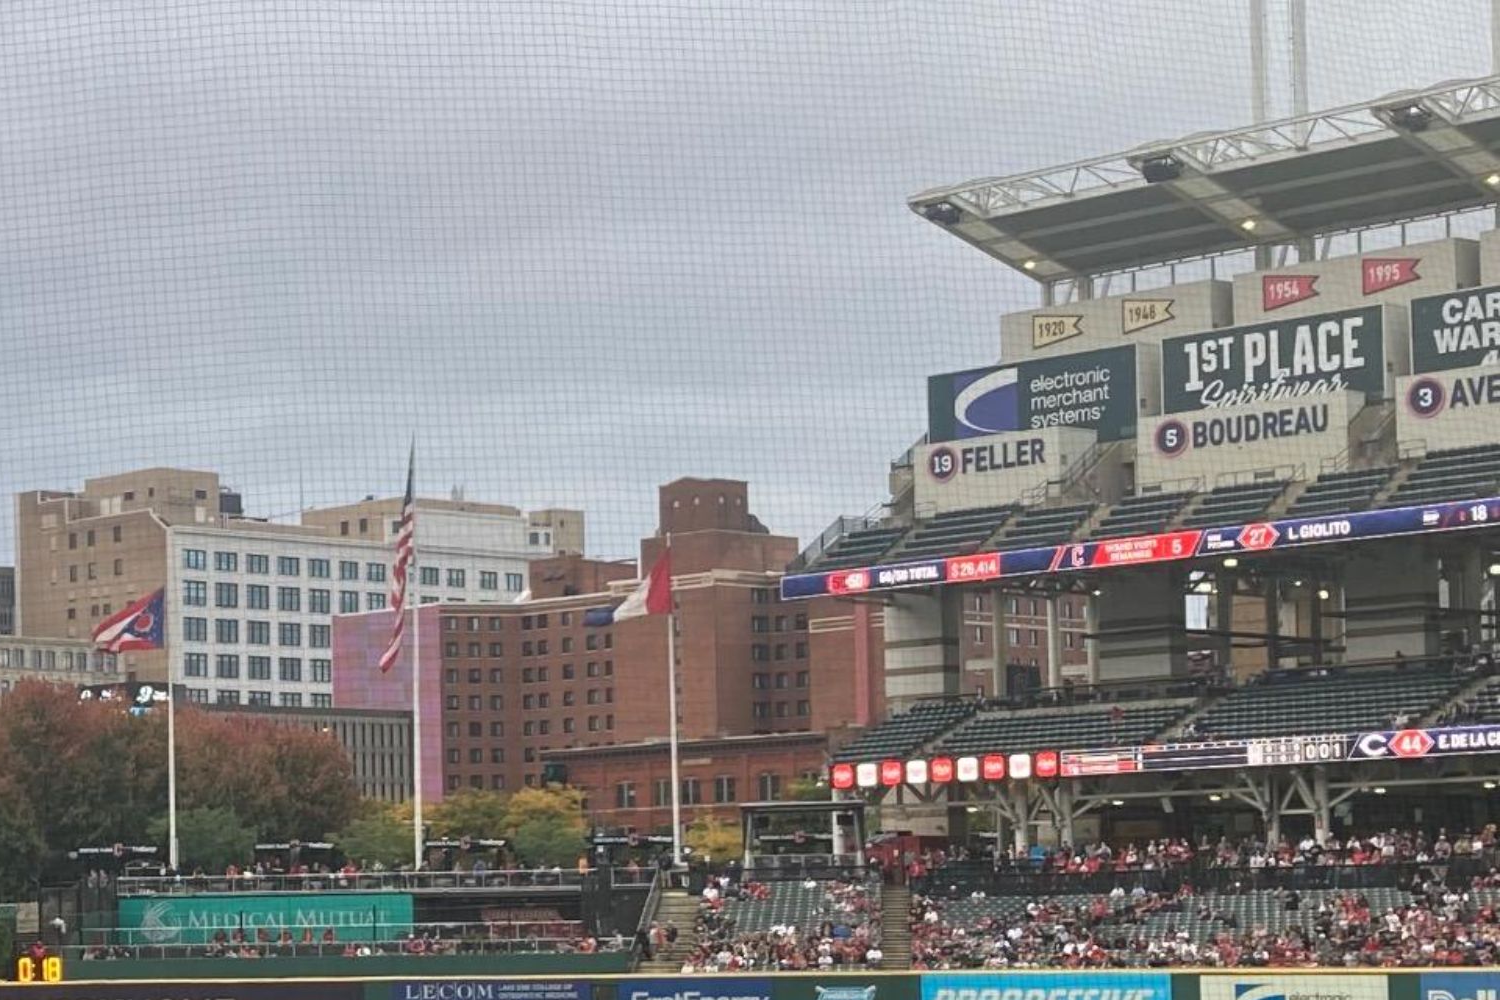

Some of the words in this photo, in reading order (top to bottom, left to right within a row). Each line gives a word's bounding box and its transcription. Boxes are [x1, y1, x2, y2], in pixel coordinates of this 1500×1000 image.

[1368, 264, 1401, 283] 1995
[1269, 281, 1300, 300] 1954
[1128, 304, 1156, 323] 1948
[1038, 320, 1065, 338] 1920
[1184, 336, 1234, 393] 1ST
[1243, 316, 1366, 386] PLACE
[1030, 366, 1111, 392] electronic
[1030, 384, 1110, 411] merchant
[1418, 387, 1433, 407] 3
[1030, 406, 1102, 429] systems
[1165, 429, 1178, 447] 5
[1192, 404, 1329, 449] BOUDREAU
[933, 455, 952, 473] 19
[962, 438, 1046, 474] FELLER
[1250, 531, 1266, 545] 27
[1299, 521, 1350, 539] GIOLITO
[1470, 505, 1487, 520] 18
[1401, 735, 1421, 752] 44
[1451, 733, 1468, 747] DE
[1470, 732, 1486, 746] LA
